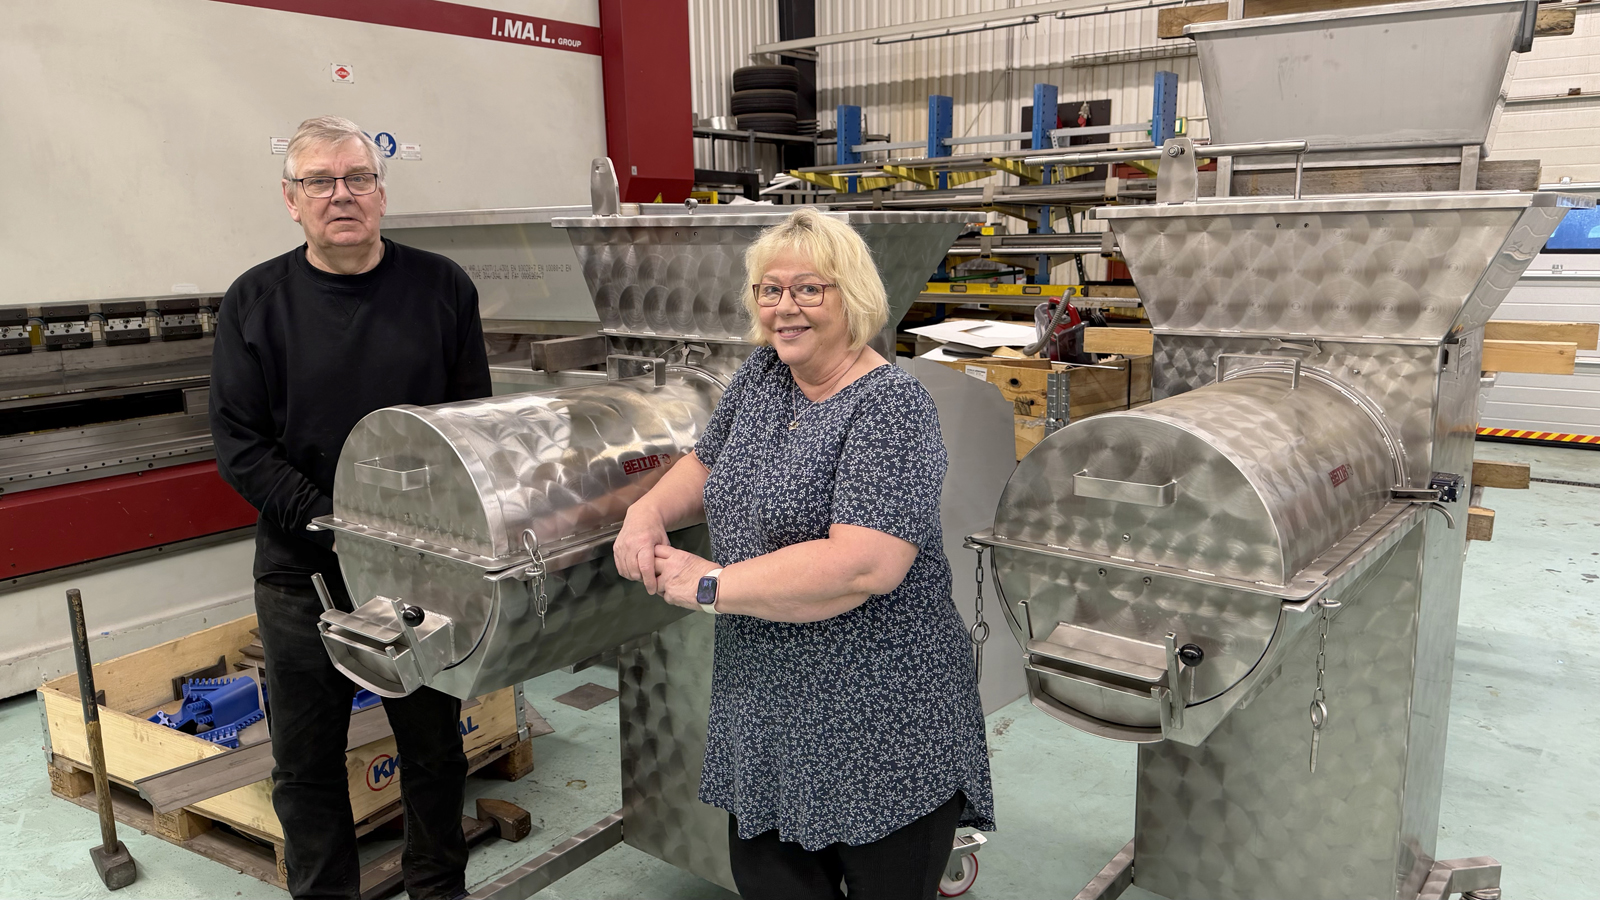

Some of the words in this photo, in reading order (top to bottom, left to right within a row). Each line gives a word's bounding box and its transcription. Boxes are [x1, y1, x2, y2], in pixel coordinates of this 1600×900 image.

[491, 17, 555, 44] I.MA.L.
[557, 37, 582, 47] GROUP
[623, 454, 662, 474] BEITIR
